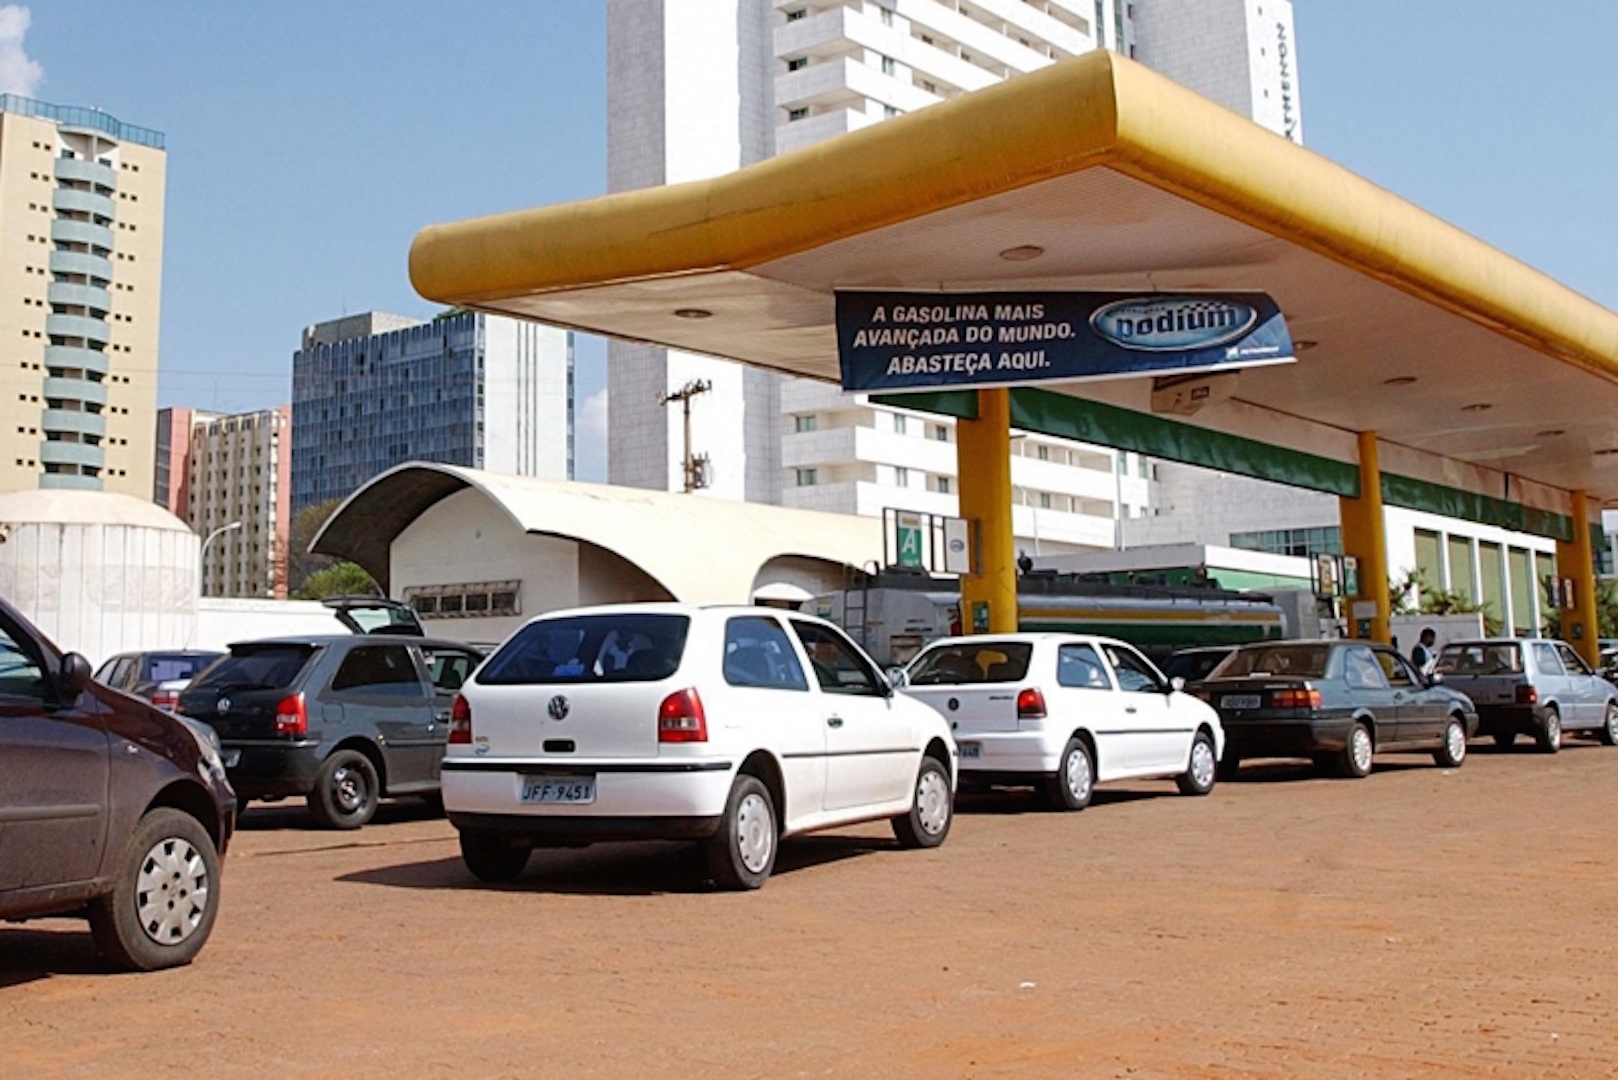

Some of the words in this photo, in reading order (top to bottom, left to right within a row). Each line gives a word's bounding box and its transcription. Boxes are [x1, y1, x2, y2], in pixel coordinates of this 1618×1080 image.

[871, 305, 887, 323] A
[892, 304, 989, 324] GASOLINA
[994, 303, 1045, 322] MAIS
[1115, 307, 1237, 338] podium
[853, 326, 960, 350] AVANÇADA
[965, 325, 993, 344] DO
[998, 321, 1077, 344] MUNDO.
[886, 352, 993, 376] ABASTEÇA
[997, 350, 1052, 371] AQUI.
[557, 785, 591, 801] 9451
